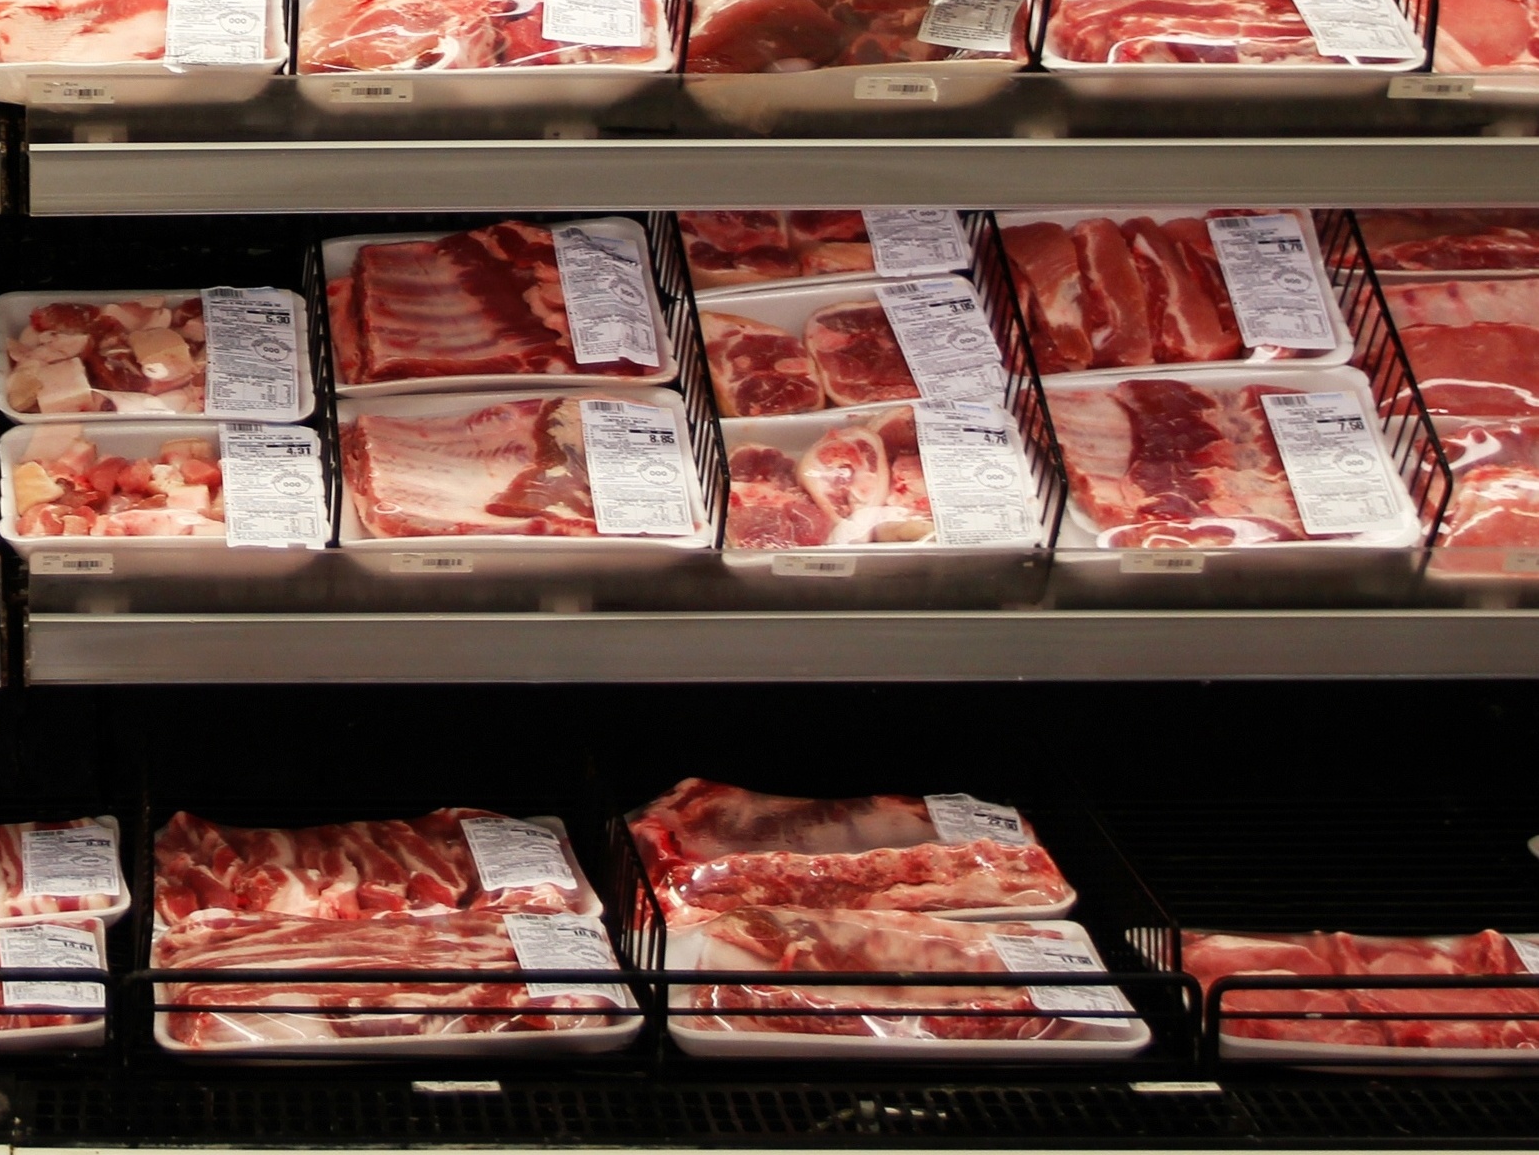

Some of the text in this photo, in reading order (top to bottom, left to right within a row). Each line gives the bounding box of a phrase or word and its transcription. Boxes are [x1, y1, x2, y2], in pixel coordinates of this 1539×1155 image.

[266, 314, 290, 324] 5.30
[649, 434, 675, 444] 8.85
[286, 447, 311, 455] 4.31
